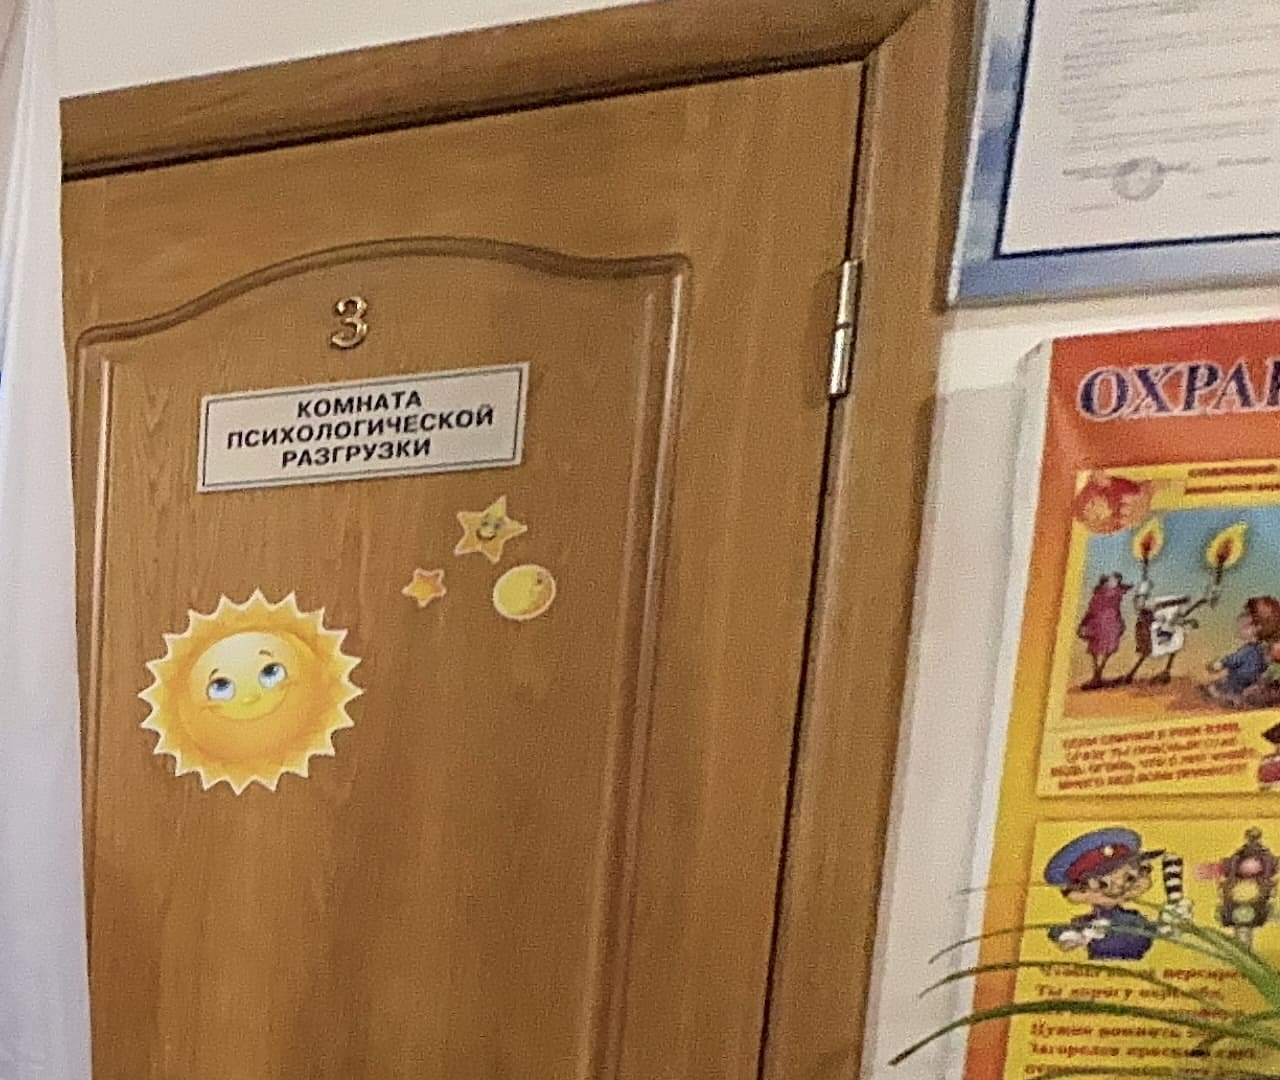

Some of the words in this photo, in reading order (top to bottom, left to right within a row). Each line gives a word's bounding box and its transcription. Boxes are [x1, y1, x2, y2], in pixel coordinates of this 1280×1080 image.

[330, 296, 369, 349] 3
[296, 390, 423, 419] КОМНАТА
[226, 403, 494, 450] ПСИХОЛОГИЧЕСКОЙ
[281, 438, 432, 469] РАЗГРУЗКИ
